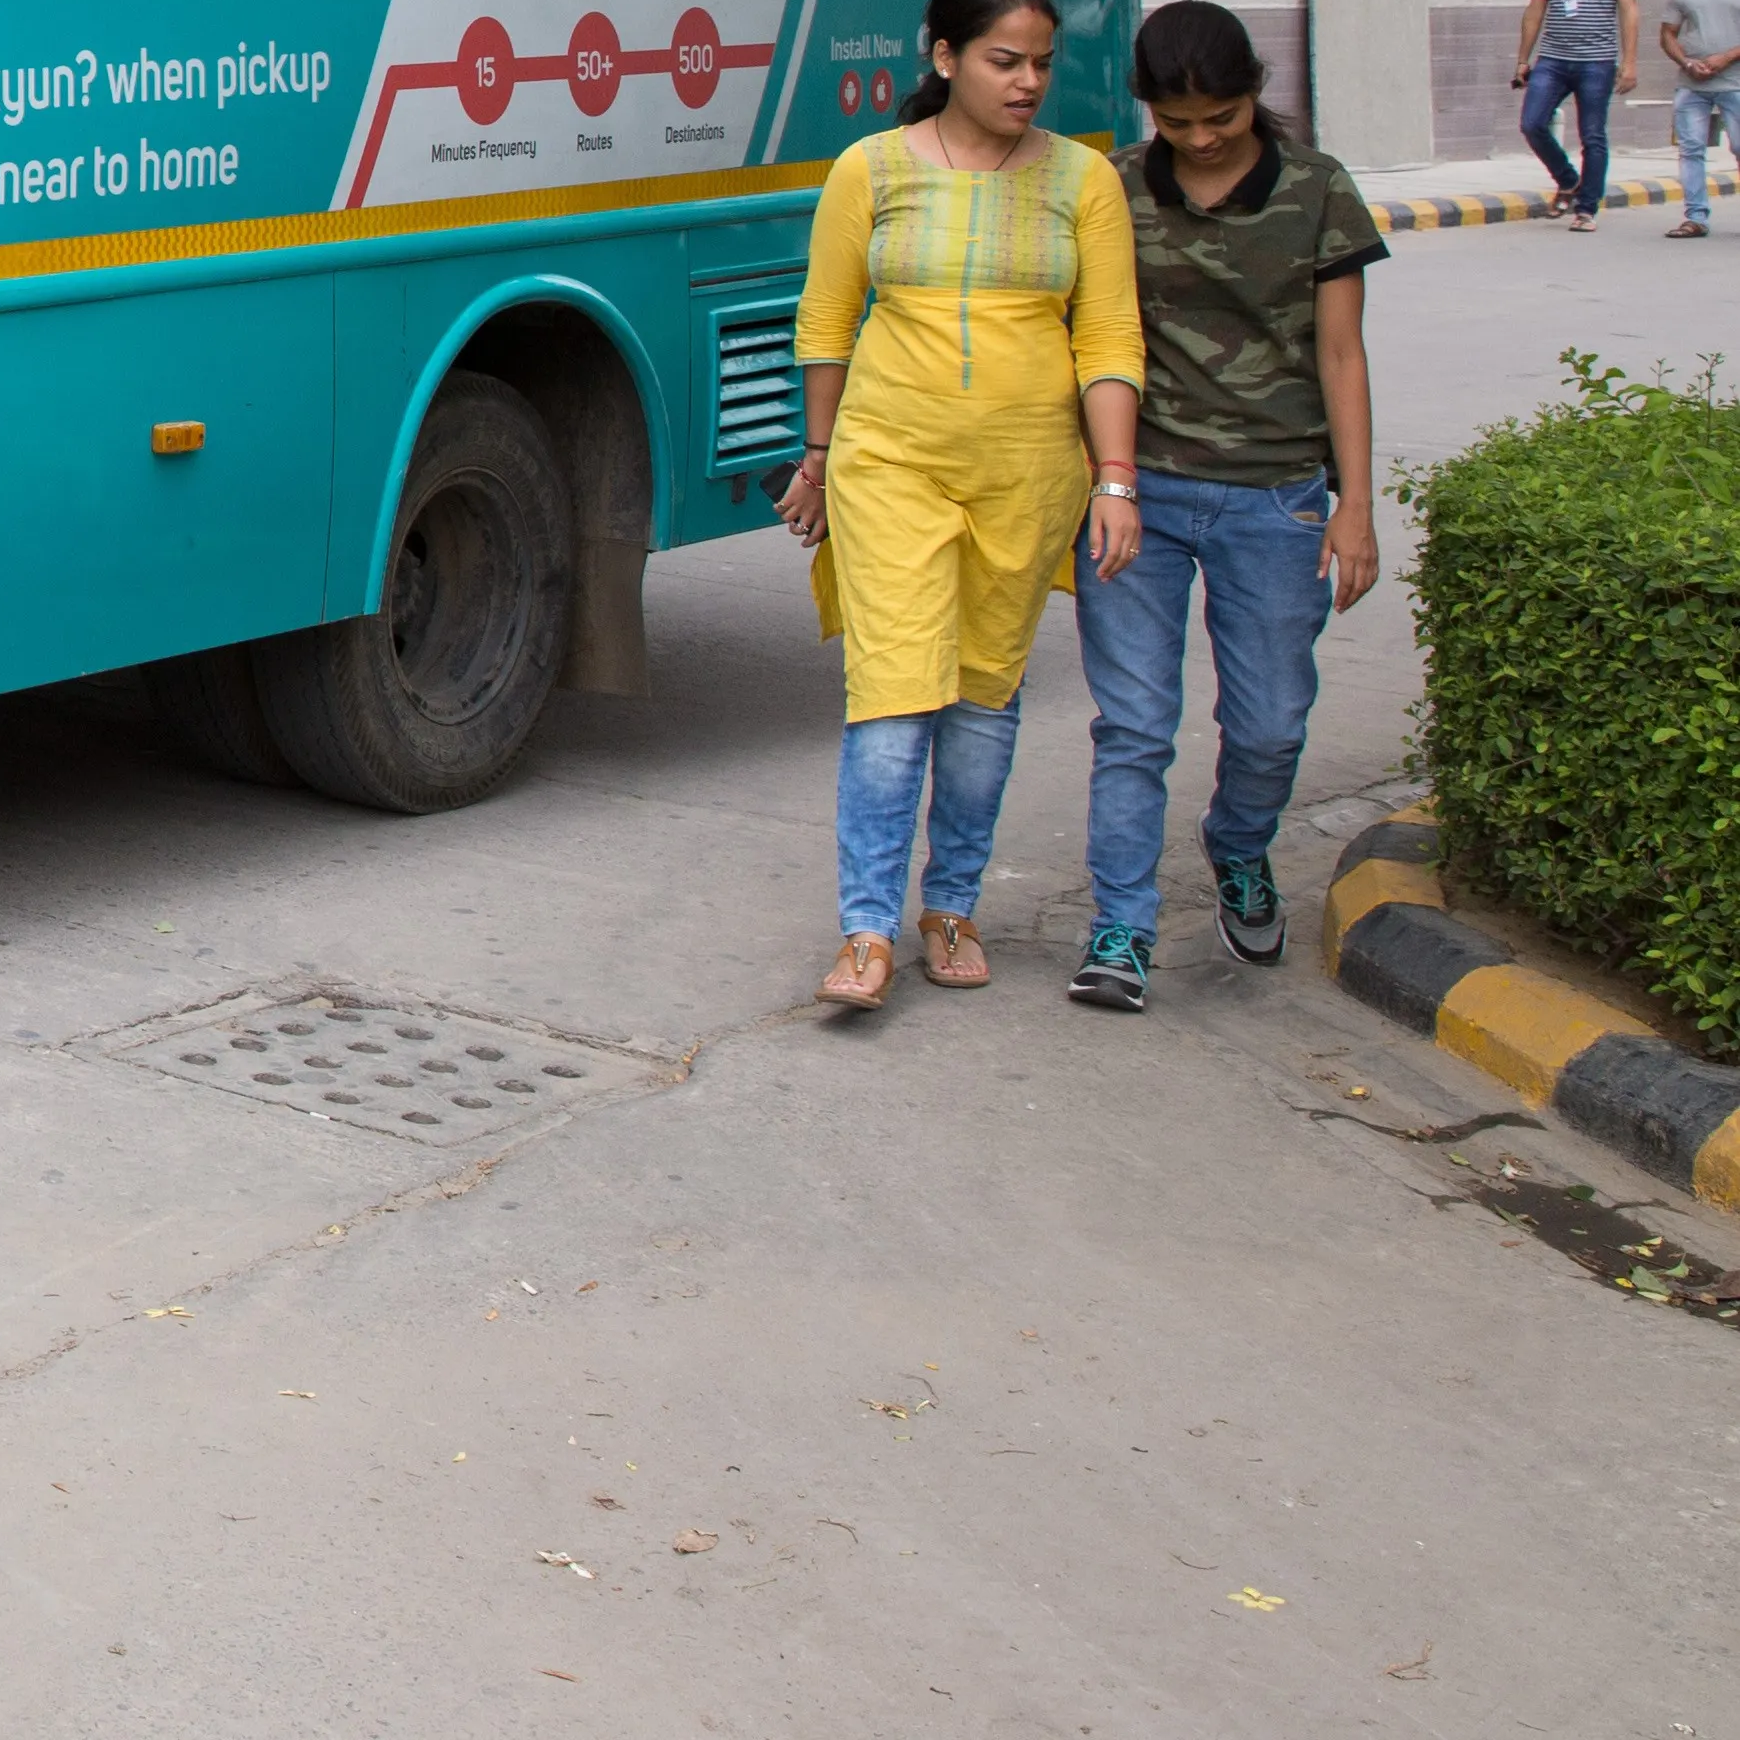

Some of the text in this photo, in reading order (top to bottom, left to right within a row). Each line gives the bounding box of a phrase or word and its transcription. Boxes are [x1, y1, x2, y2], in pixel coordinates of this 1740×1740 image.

[678, 44, 713, 75] 500
[830, 34, 871, 61] Install
[873, 33, 903, 58] Now
[106, 47, 206, 104] when
[217, 40, 331, 109] pickup
[475, 56, 496, 88] 15
[576, 50, 614, 82] 50+
[576, 133, 613, 152] Routes
[665, 123, 725, 144] Destinations
[431, 139, 537, 163] Minutes Frequency
[93, 146, 129, 197] to
[139, 137, 240, 193] home
